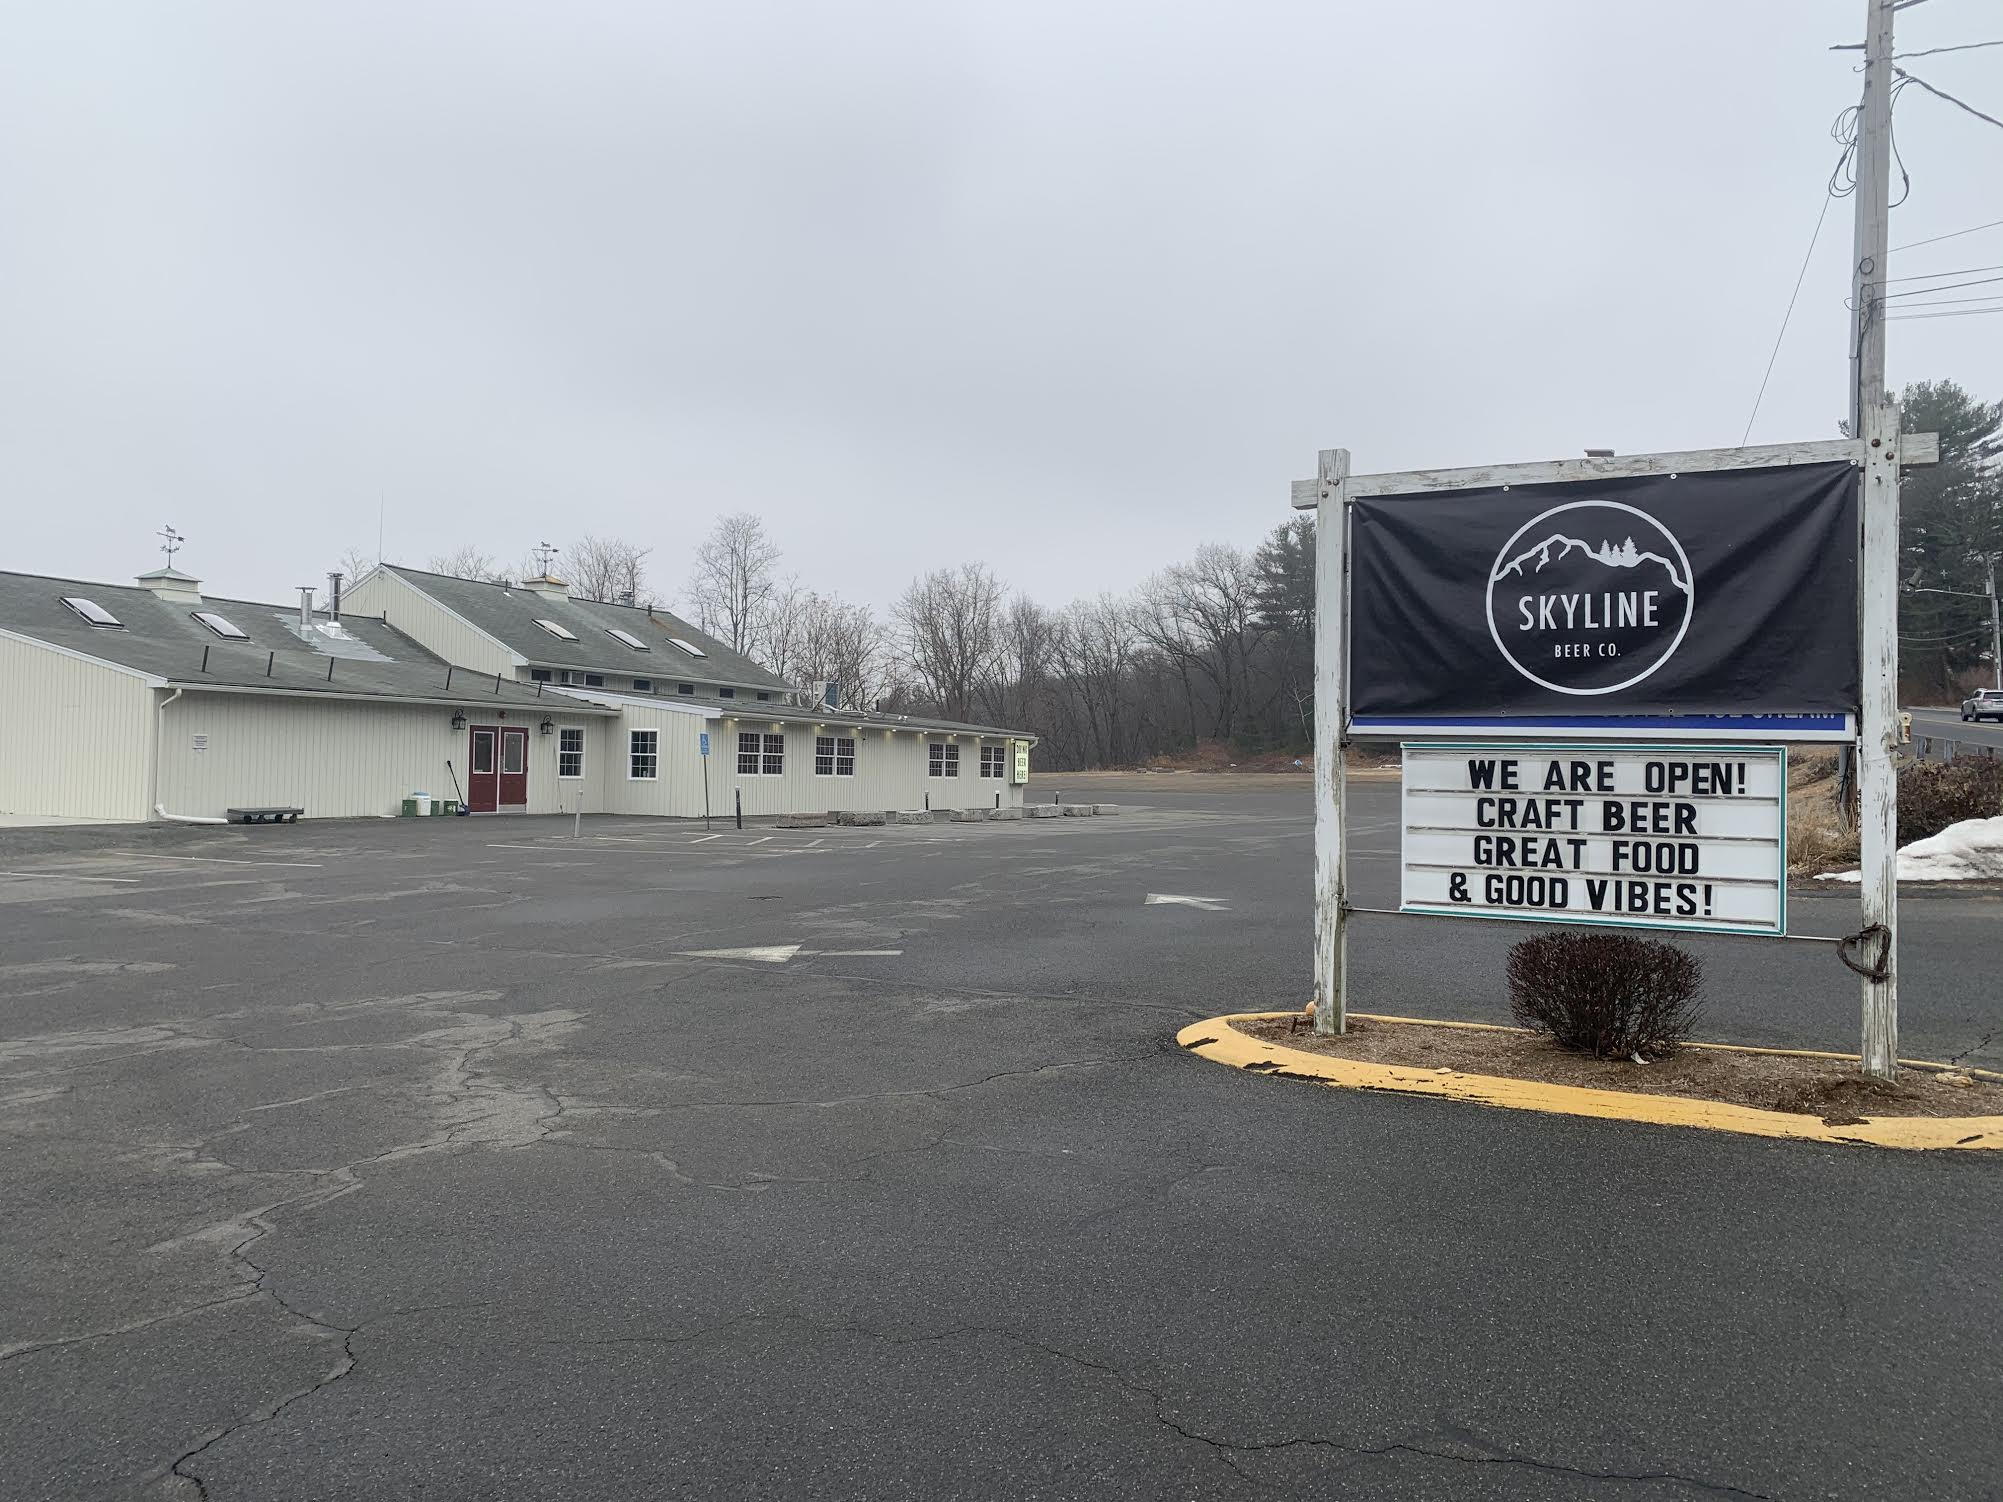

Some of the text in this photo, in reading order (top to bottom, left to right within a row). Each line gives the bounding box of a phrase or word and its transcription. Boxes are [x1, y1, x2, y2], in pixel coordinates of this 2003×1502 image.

[1518, 591, 1659, 631] SKYLINE
[1554, 643, 1621, 658] BEER CO.
[1468, 759, 1746, 795] WE ARE OPEN!
[1476, 797, 1698, 834] CRAFT BEER
[1473, 835, 1699, 875] GREAT FOOD
[1449, 872, 1713, 916] & GOOD VIBES!
